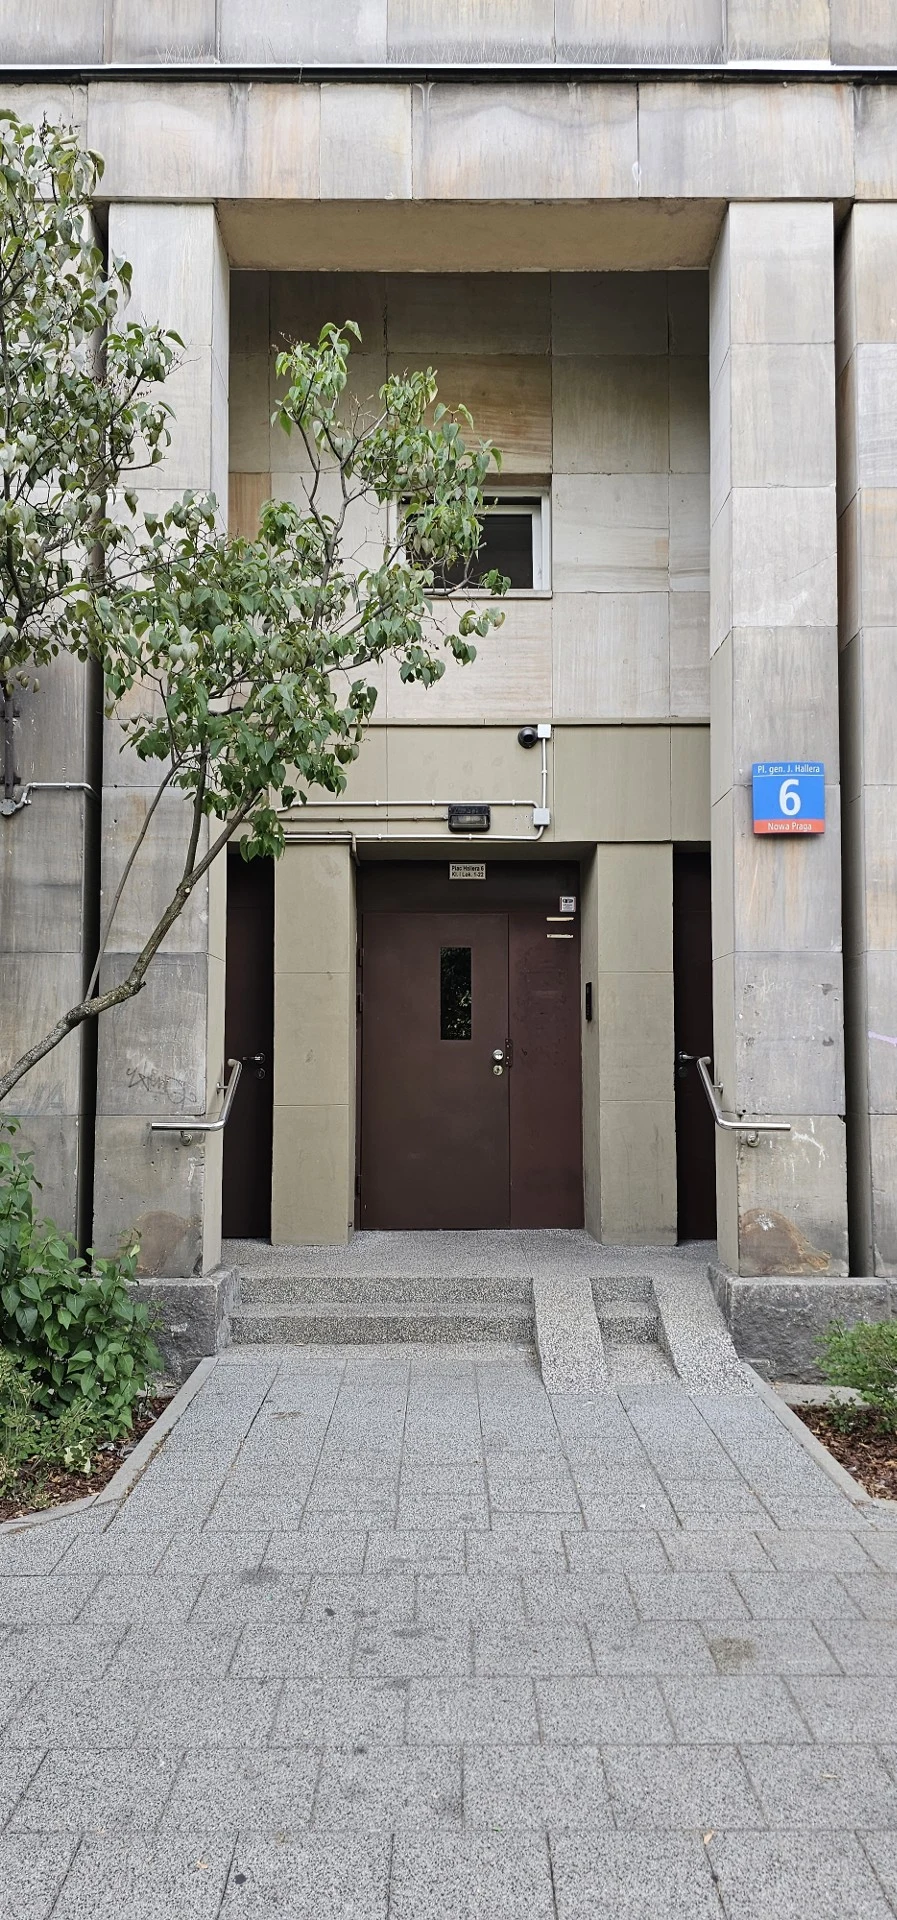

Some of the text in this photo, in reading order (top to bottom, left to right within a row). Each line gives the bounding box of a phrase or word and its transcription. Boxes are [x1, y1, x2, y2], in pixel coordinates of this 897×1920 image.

[757, 764, 820, 775] Pl. gen. J. Hallera
[779, 778, 801, 816] 6
[767, 821, 812, 832] Nowa Praga
